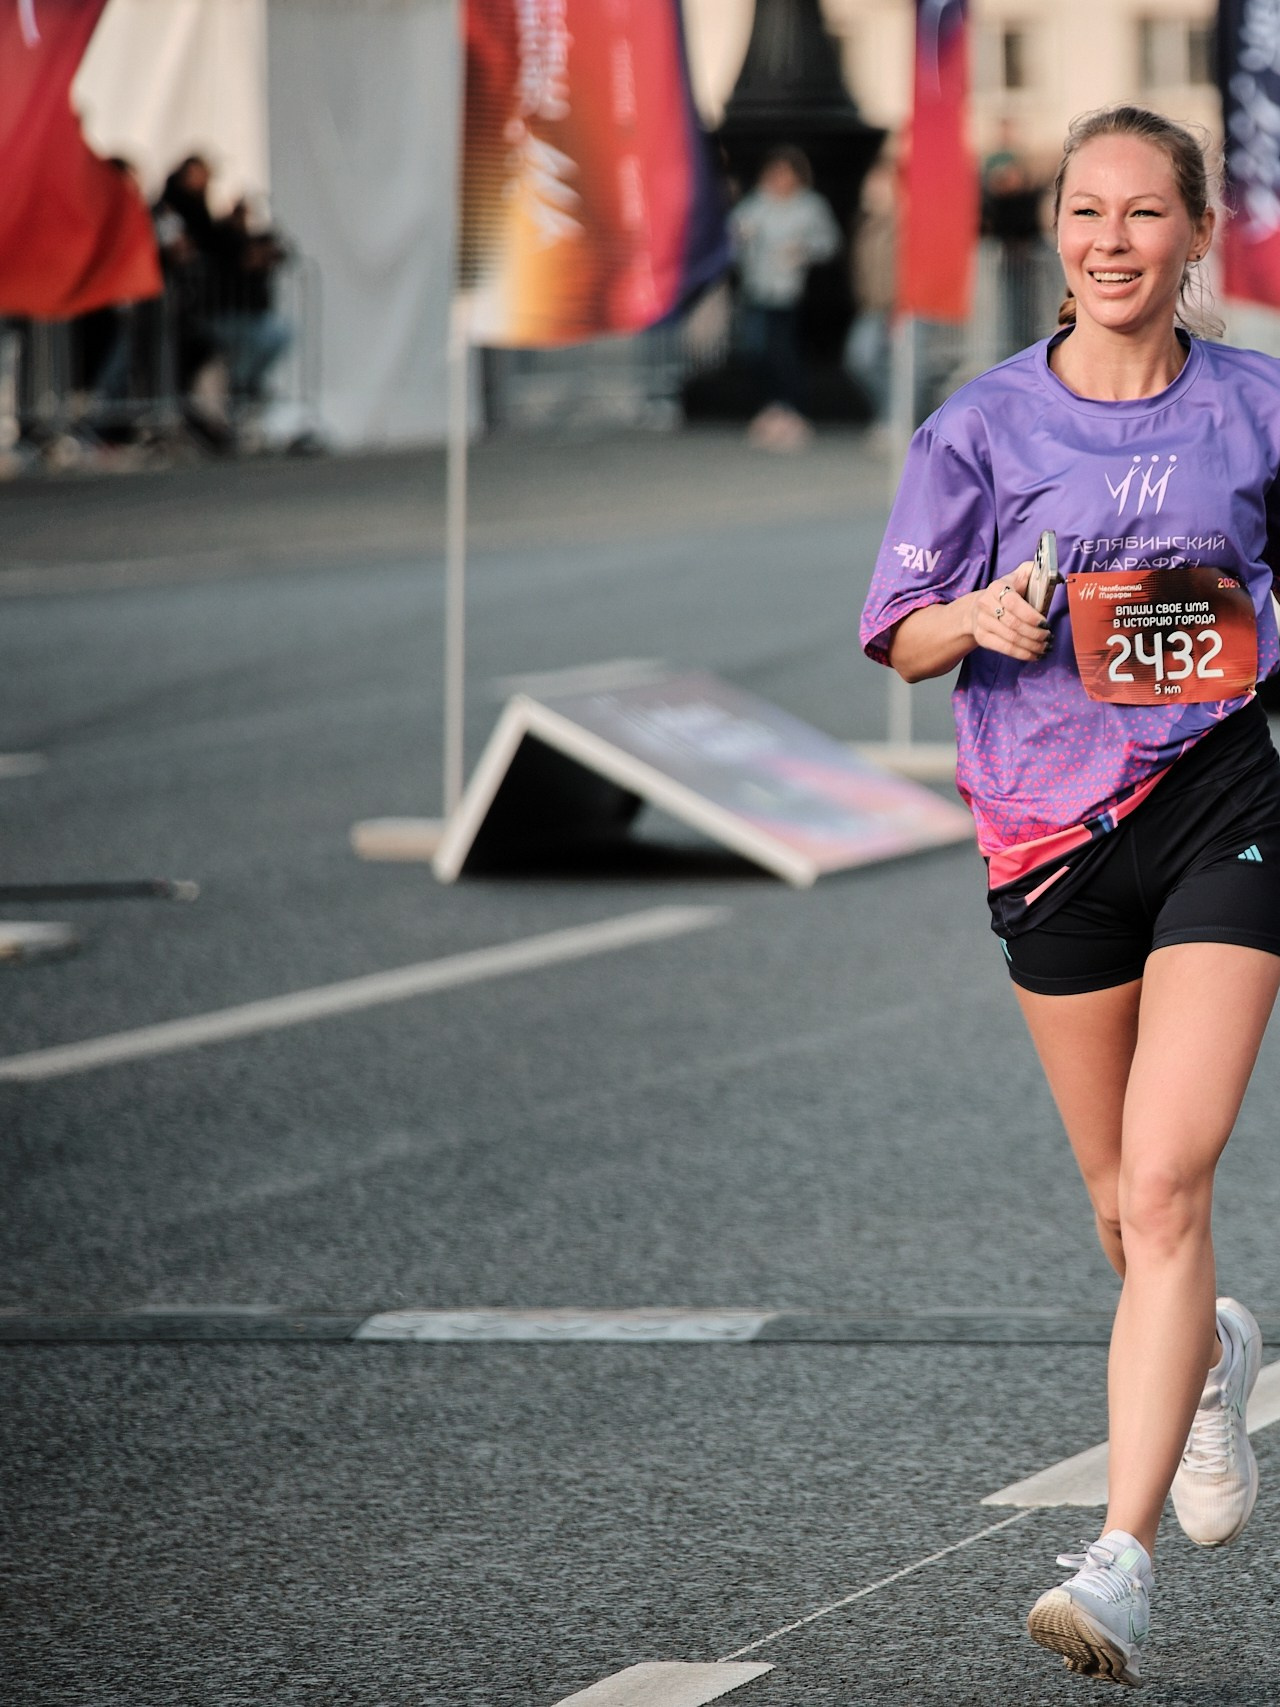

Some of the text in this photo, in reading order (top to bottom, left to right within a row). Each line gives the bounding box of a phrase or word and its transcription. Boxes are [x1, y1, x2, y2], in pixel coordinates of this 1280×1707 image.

[1155, 603, 1183, 614] СВОЕ
[1113, 614, 1216, 629] В ИСТОРИЮ ГОРОДА
[1106, 629, 1224, 682] 2432
[1154, 684, 1162, 695] 5
